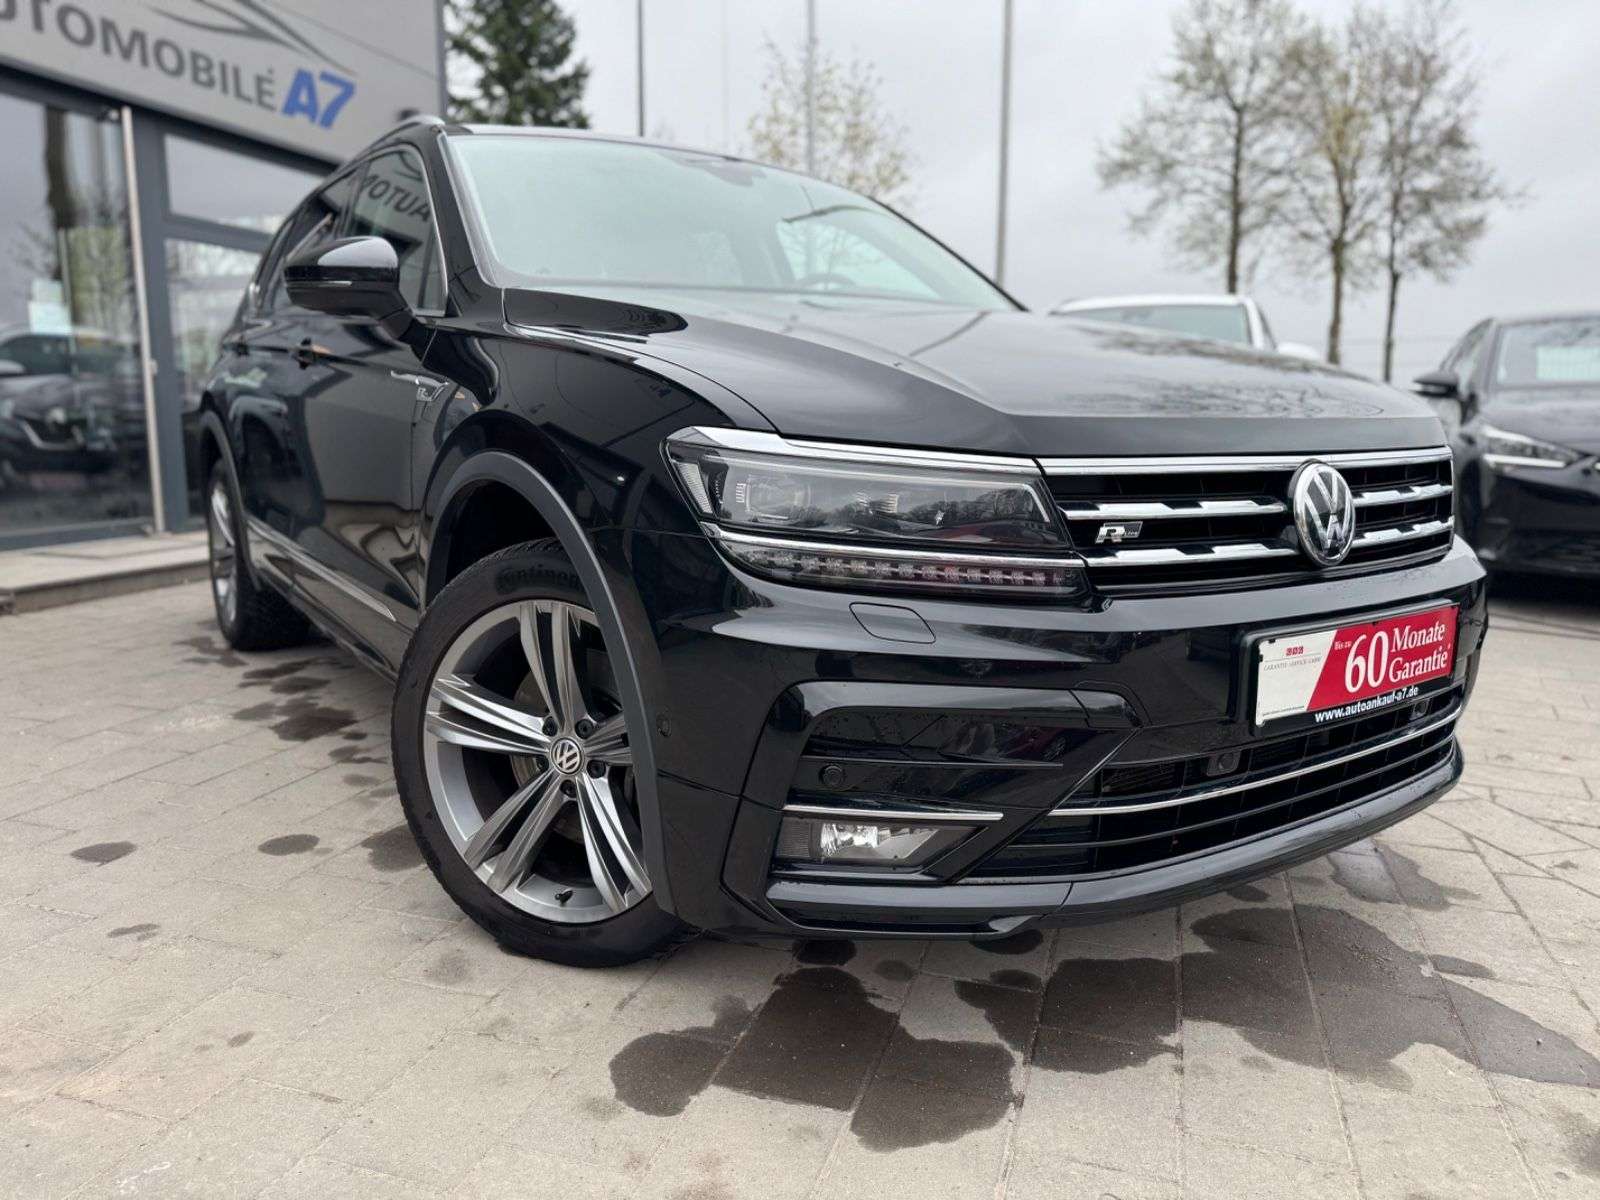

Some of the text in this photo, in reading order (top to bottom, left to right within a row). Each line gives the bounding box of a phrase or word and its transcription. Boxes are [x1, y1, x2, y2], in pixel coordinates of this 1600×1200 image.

[281, 68, 357, 130] A7
[1345, 630, 1390, 693] 60
[1390, 620, 1446, 653] Monate
[1315, 685, 1419, 723] www.autoankauf-a7.de
